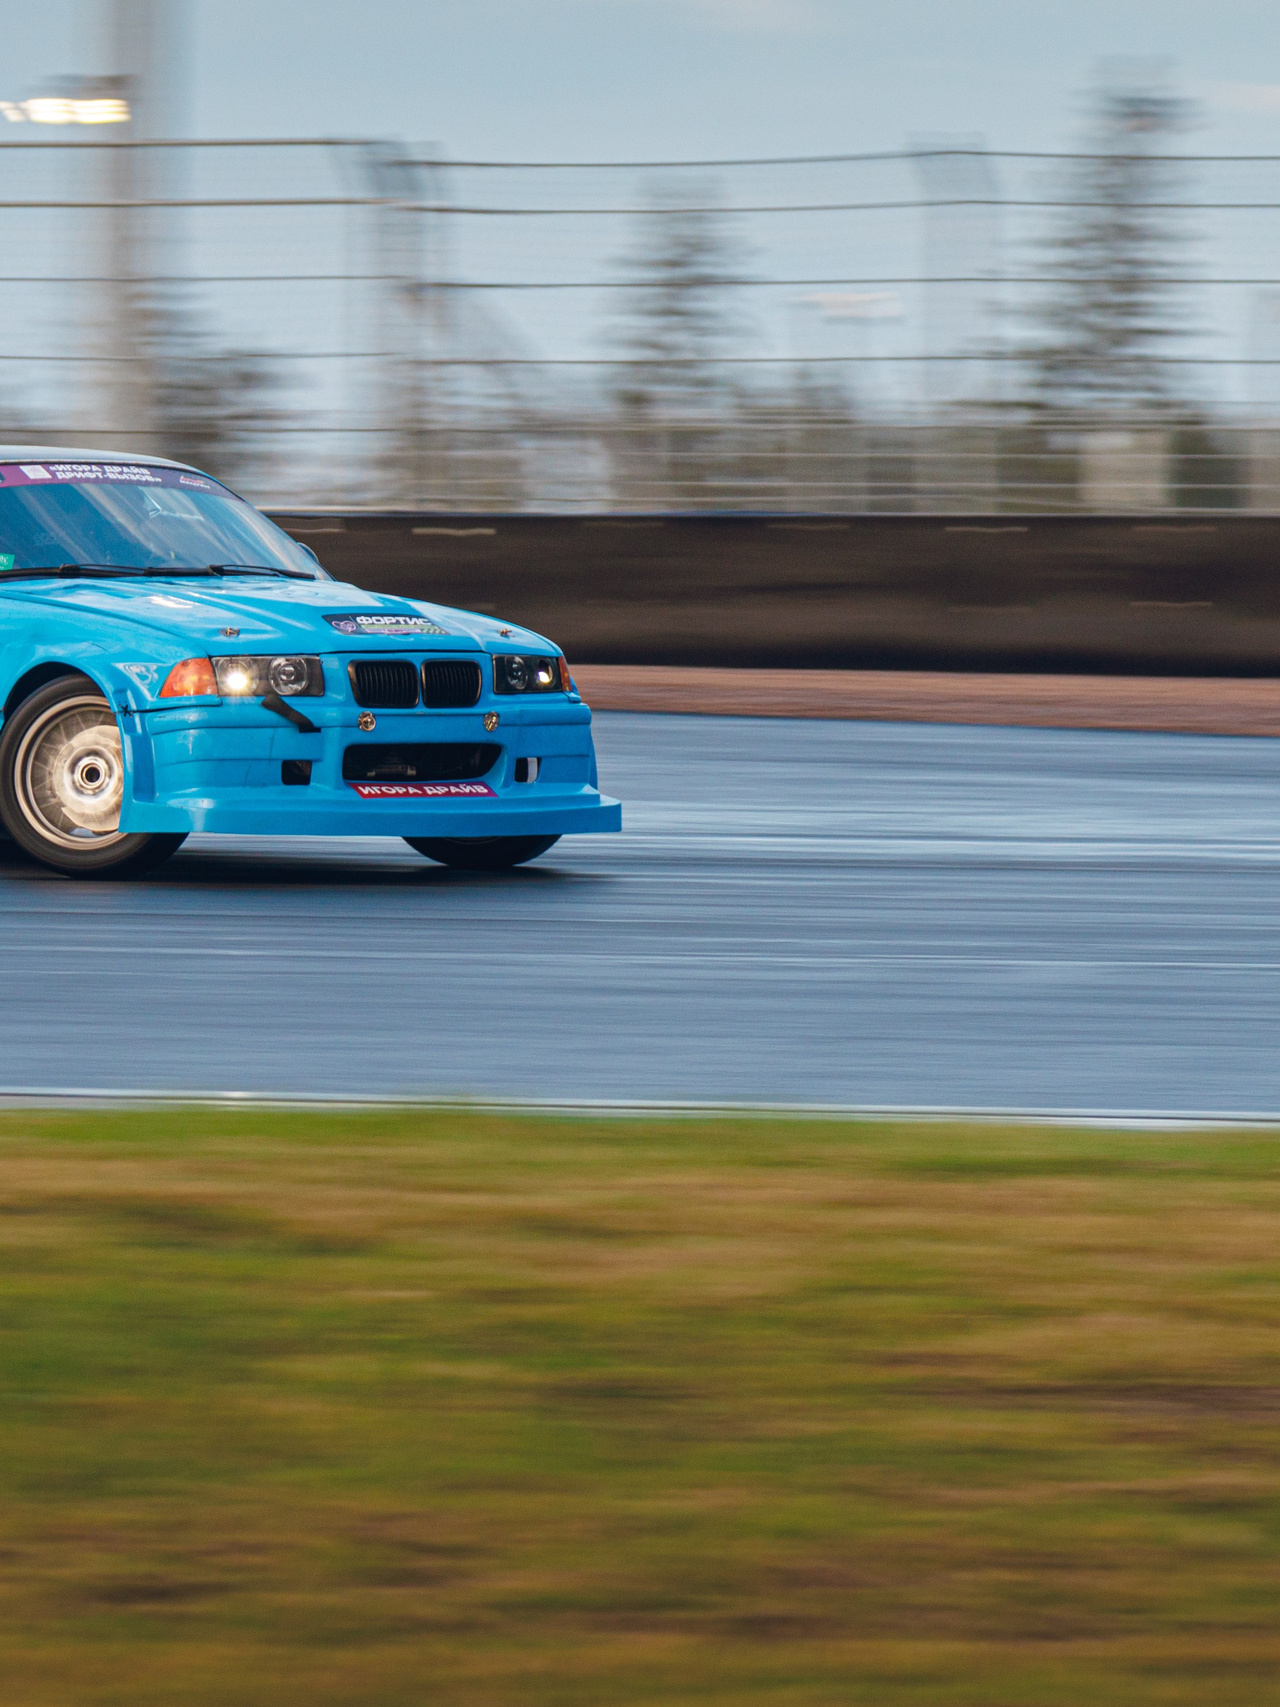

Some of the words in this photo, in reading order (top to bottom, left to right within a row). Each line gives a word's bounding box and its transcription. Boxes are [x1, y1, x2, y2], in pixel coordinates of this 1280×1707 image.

[49, 464, 102, 472] «ИГОРА
[104, 466, 151, 475] ДРАЙВ
[55, 471, 162, 483] ДРИФТ-ВЫЗОВ»
[356, 615, 432, 626] ФОРТИС
[358, 785, 422, 795] ИГОРА
[423, 783, 488, 795] ДРАЙВ
